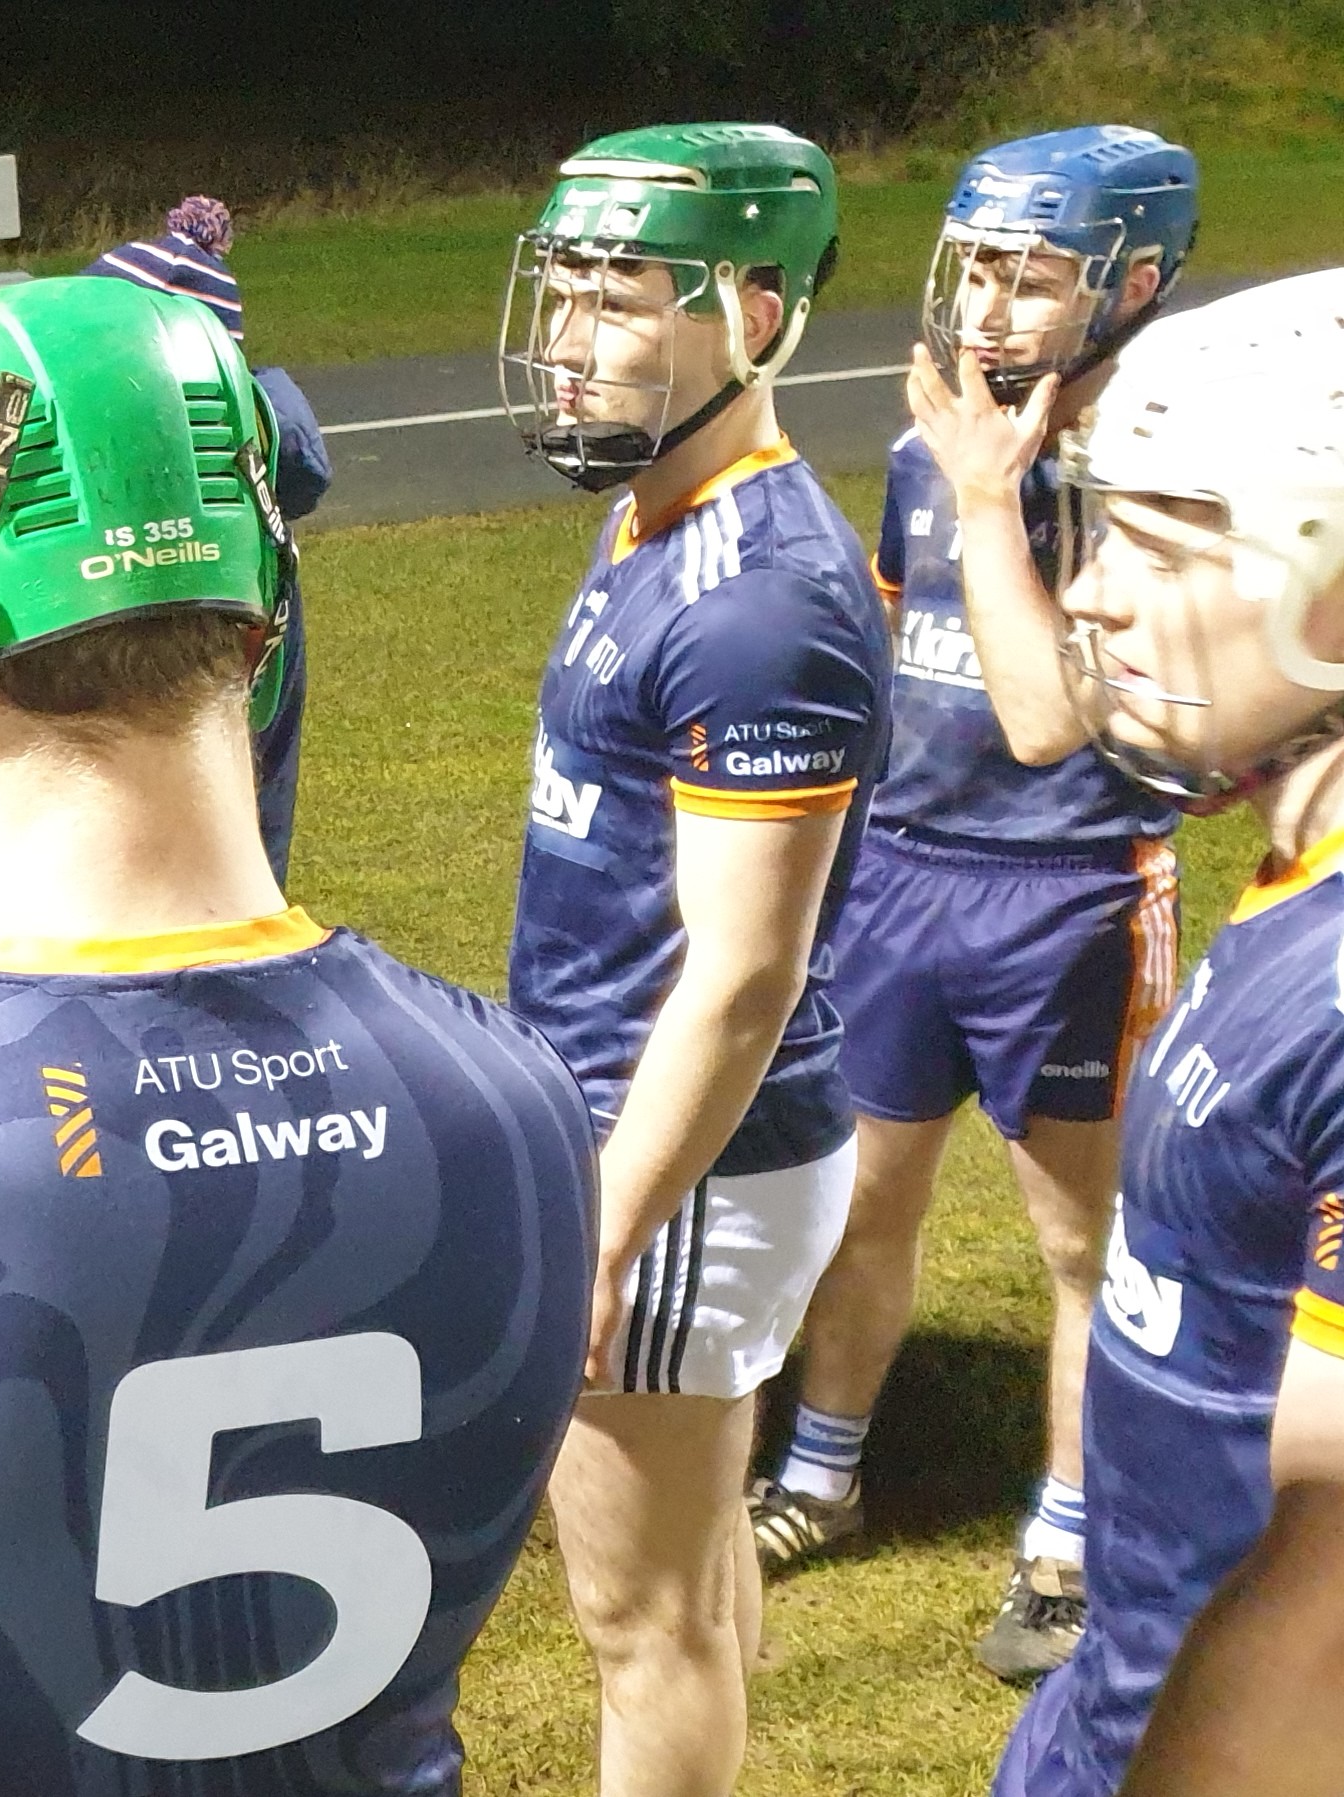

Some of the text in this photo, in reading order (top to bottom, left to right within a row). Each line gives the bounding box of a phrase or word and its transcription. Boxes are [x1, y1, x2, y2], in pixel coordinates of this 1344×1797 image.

[143, 517, 194, 543] 355
[80, 541, 221, 580] O'Neills
[585, 633, 626, 686] ATU
[723, 724, 771, 742] ATU
[725, 746, 847, 777] Galway
[134, 1039, 349, 1095] ATU Sport
[1165, 1042, 1232, 1128] ATU
[144, 1105, 388, 1173] Galway
[75, 1331, 433, 1761] 5
